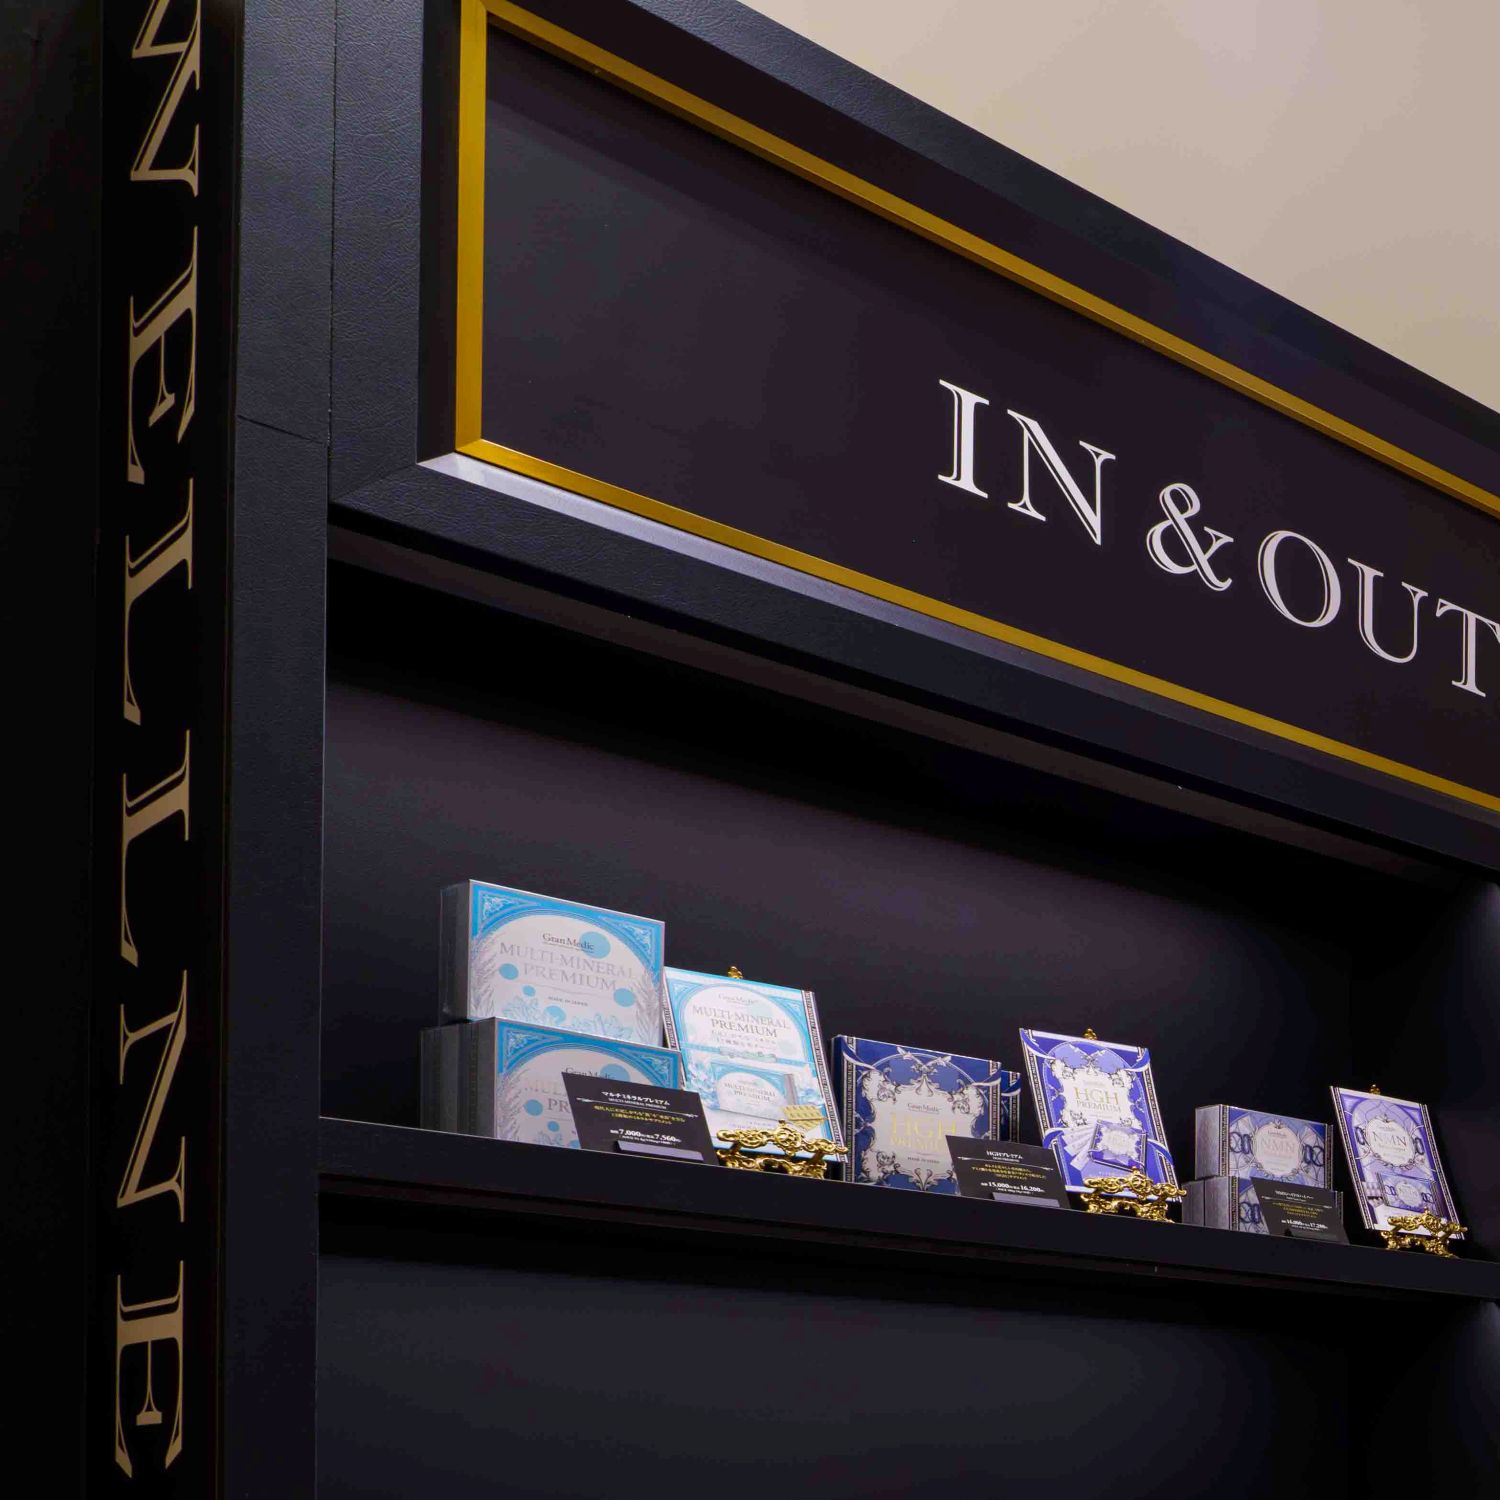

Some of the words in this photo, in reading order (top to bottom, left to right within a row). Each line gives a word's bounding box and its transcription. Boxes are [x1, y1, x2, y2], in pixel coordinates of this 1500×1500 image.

[937, 379, 1116, 546] IN
[1146, 483, 1234, 591] &
[500, 942, 637, 981] MULTI-MINERAL
[524, 962, 618, 991] PREMIUM
[692, 1005, 790, 1029] MULTI-MINERAL
[711, 1018, 777, 1037] PREMIUM
[1075, 1087, 1119, 1106] HGH
[1260, 1137, 1295, 1155] NMN
[1373, 1132, 1407, 1147] NMN
